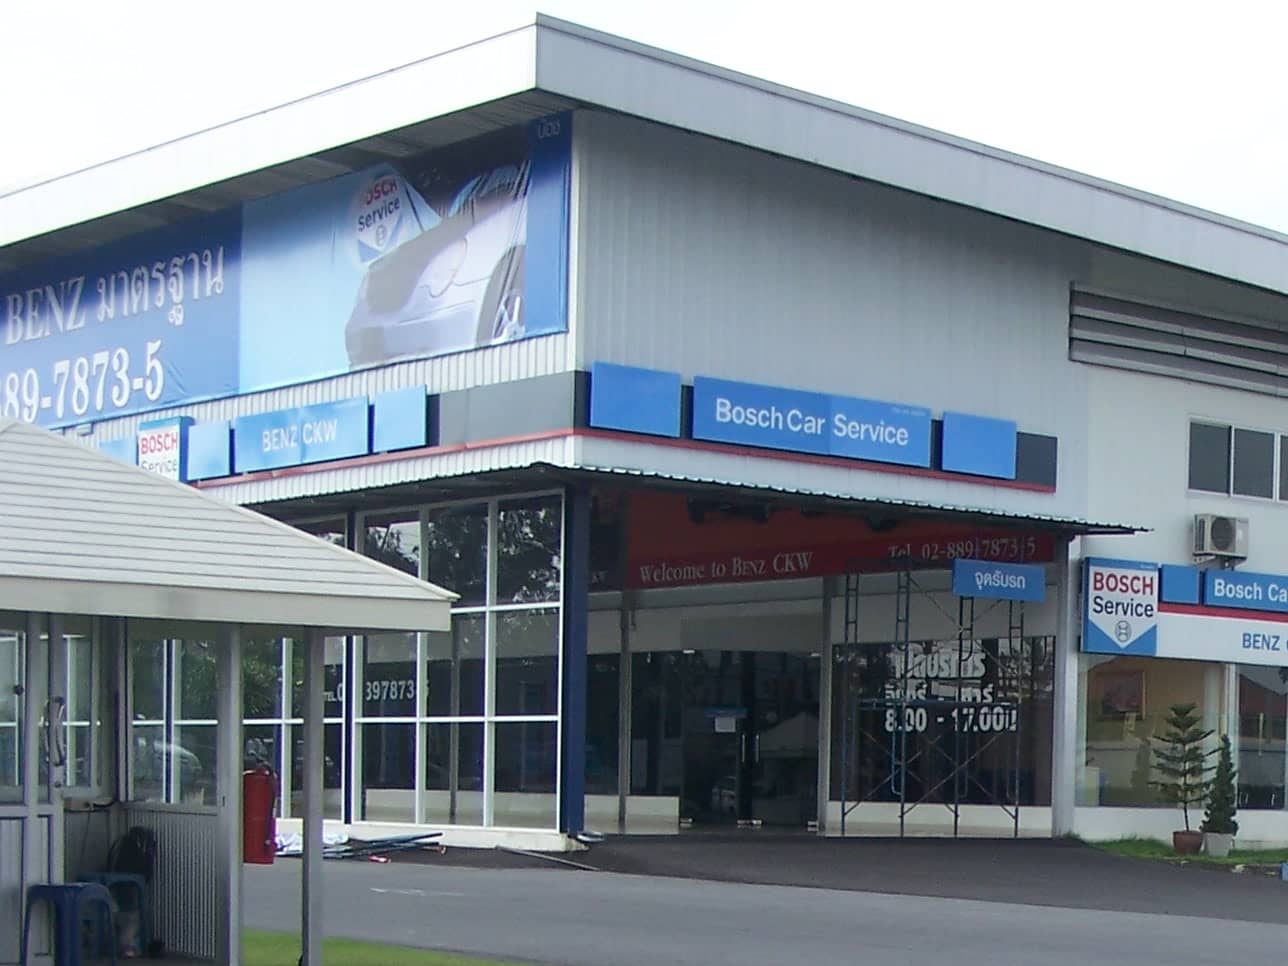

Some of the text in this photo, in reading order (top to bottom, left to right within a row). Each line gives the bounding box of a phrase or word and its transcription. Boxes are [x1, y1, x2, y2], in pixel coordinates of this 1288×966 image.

[360, 179, 398, 206] OSCH
[358, 198, 400, 232] Service
[6, 246, 224, 345] BENZ มาตรฐาน
[0, 340, 164, 423] 89-7873-5
[715, 398, 909, 446] Bosch Car Service
[140, 431, 178, 455] BOSCH
[262, 419, 338, 453] BENZ CKW
[639, 561, 705, 584] Welcome
[711, 561, 727, 578] to
[772, 551, 814, 574] CKW
[974, 570, 1026, 590] จุดรับรถ
[1093, 571, 1154, 596] BOSCH
[1213, 578, 1262, 600] Bosch
[1092, 595, 1154, 618] Service
[1242, 632, 1281, 652] BENZ
[885, 707, 928, 733] 8.00
